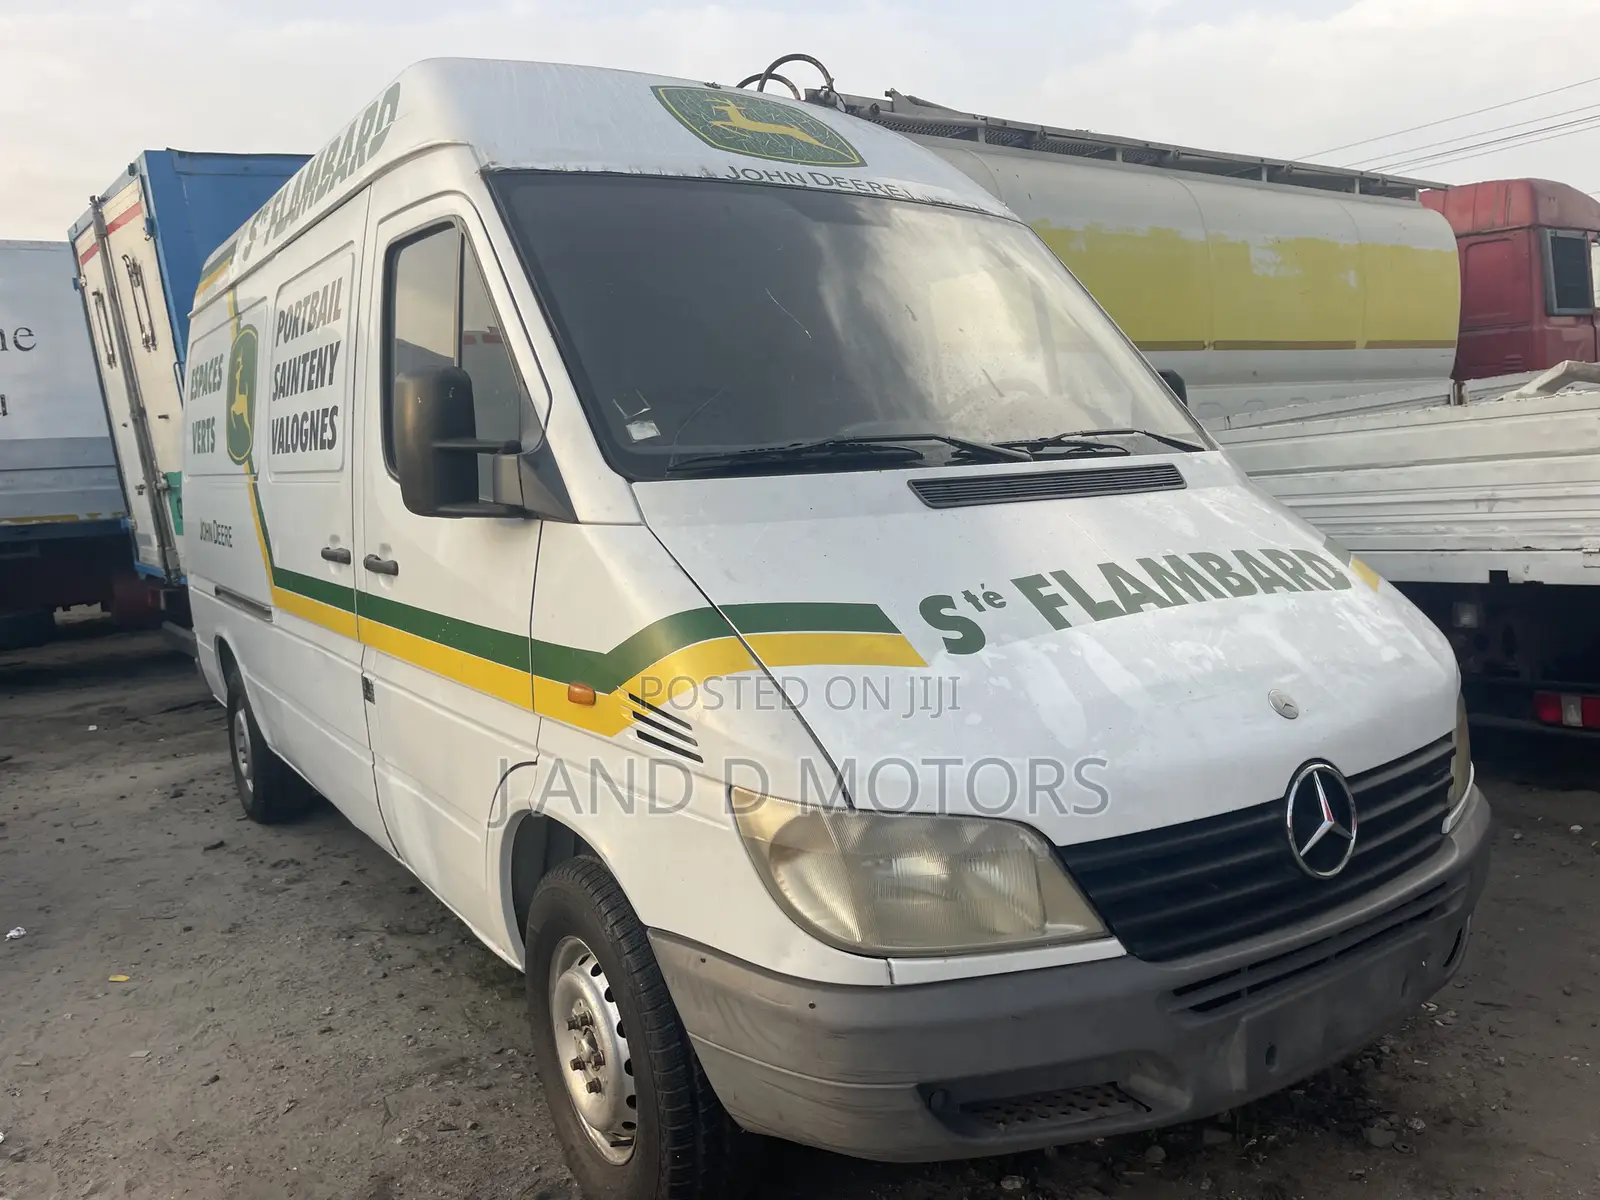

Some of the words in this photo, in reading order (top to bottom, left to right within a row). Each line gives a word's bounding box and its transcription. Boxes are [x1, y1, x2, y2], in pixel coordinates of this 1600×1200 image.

[264, 82, 401, 246] FLAMBARD
[726, 165, 807, 185] JOHN
[275, 277, 342, 347] PORTBAIL
[190, 353, 223, 402] ESPACES
[272, 340, 341, 402] SAINTENY
[192, 417, 216, 454] VERTS
[271, 405, 338, 455] VALOGNES
[200, 518, 213, 542] JOHN
[213, 519, 233, 548] DEERE
[1010, 548, 1352, 631] FLAMBARD
